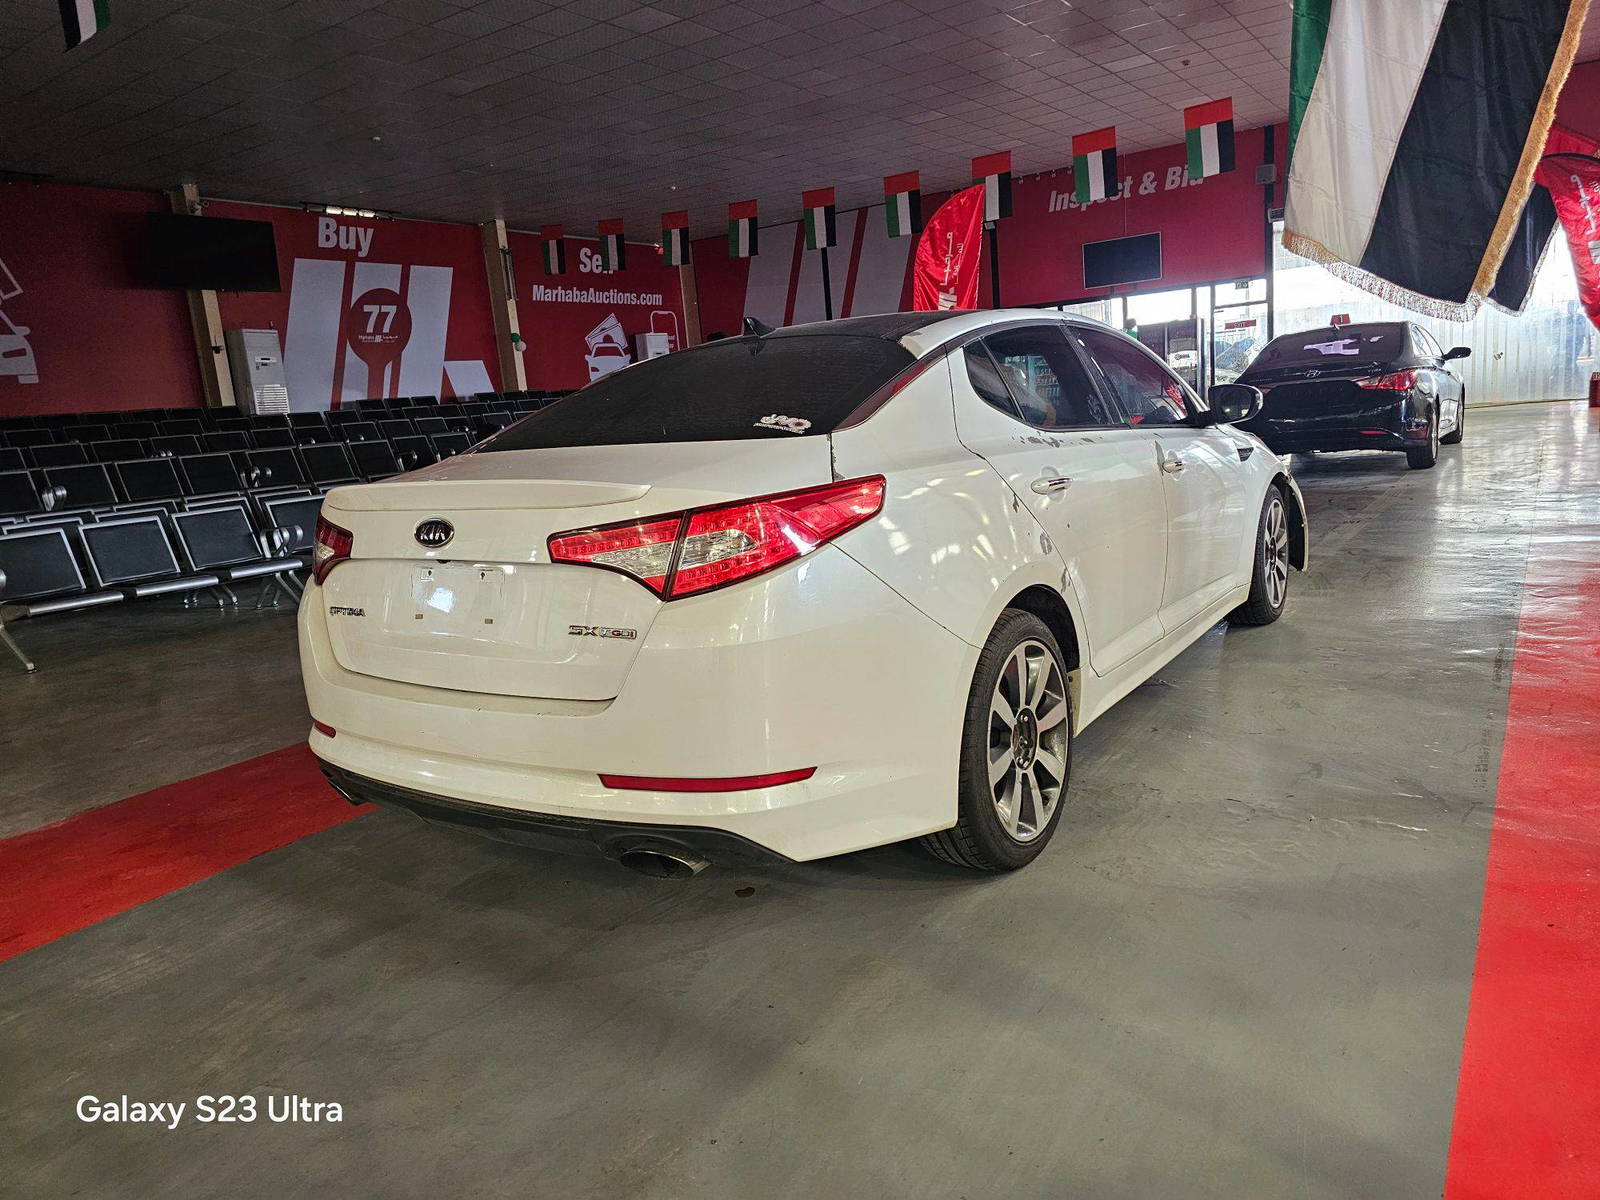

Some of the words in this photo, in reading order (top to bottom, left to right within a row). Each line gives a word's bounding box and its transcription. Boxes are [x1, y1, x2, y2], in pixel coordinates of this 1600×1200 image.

[1048, 175, 1133, 212] Inst
[1139, 171, 1157, 195] &
[1165, 164, 1204, 190] Bi
[318, 216, 374, 257] Buy
[579, 247, 614, 274] Se
[532, 284, 663, 306] MarhabaAuctions.com
[363, 305, 397, 333] 77
[420, 524, 446, 540] KIA
[568, 625, 599, 637] SX
